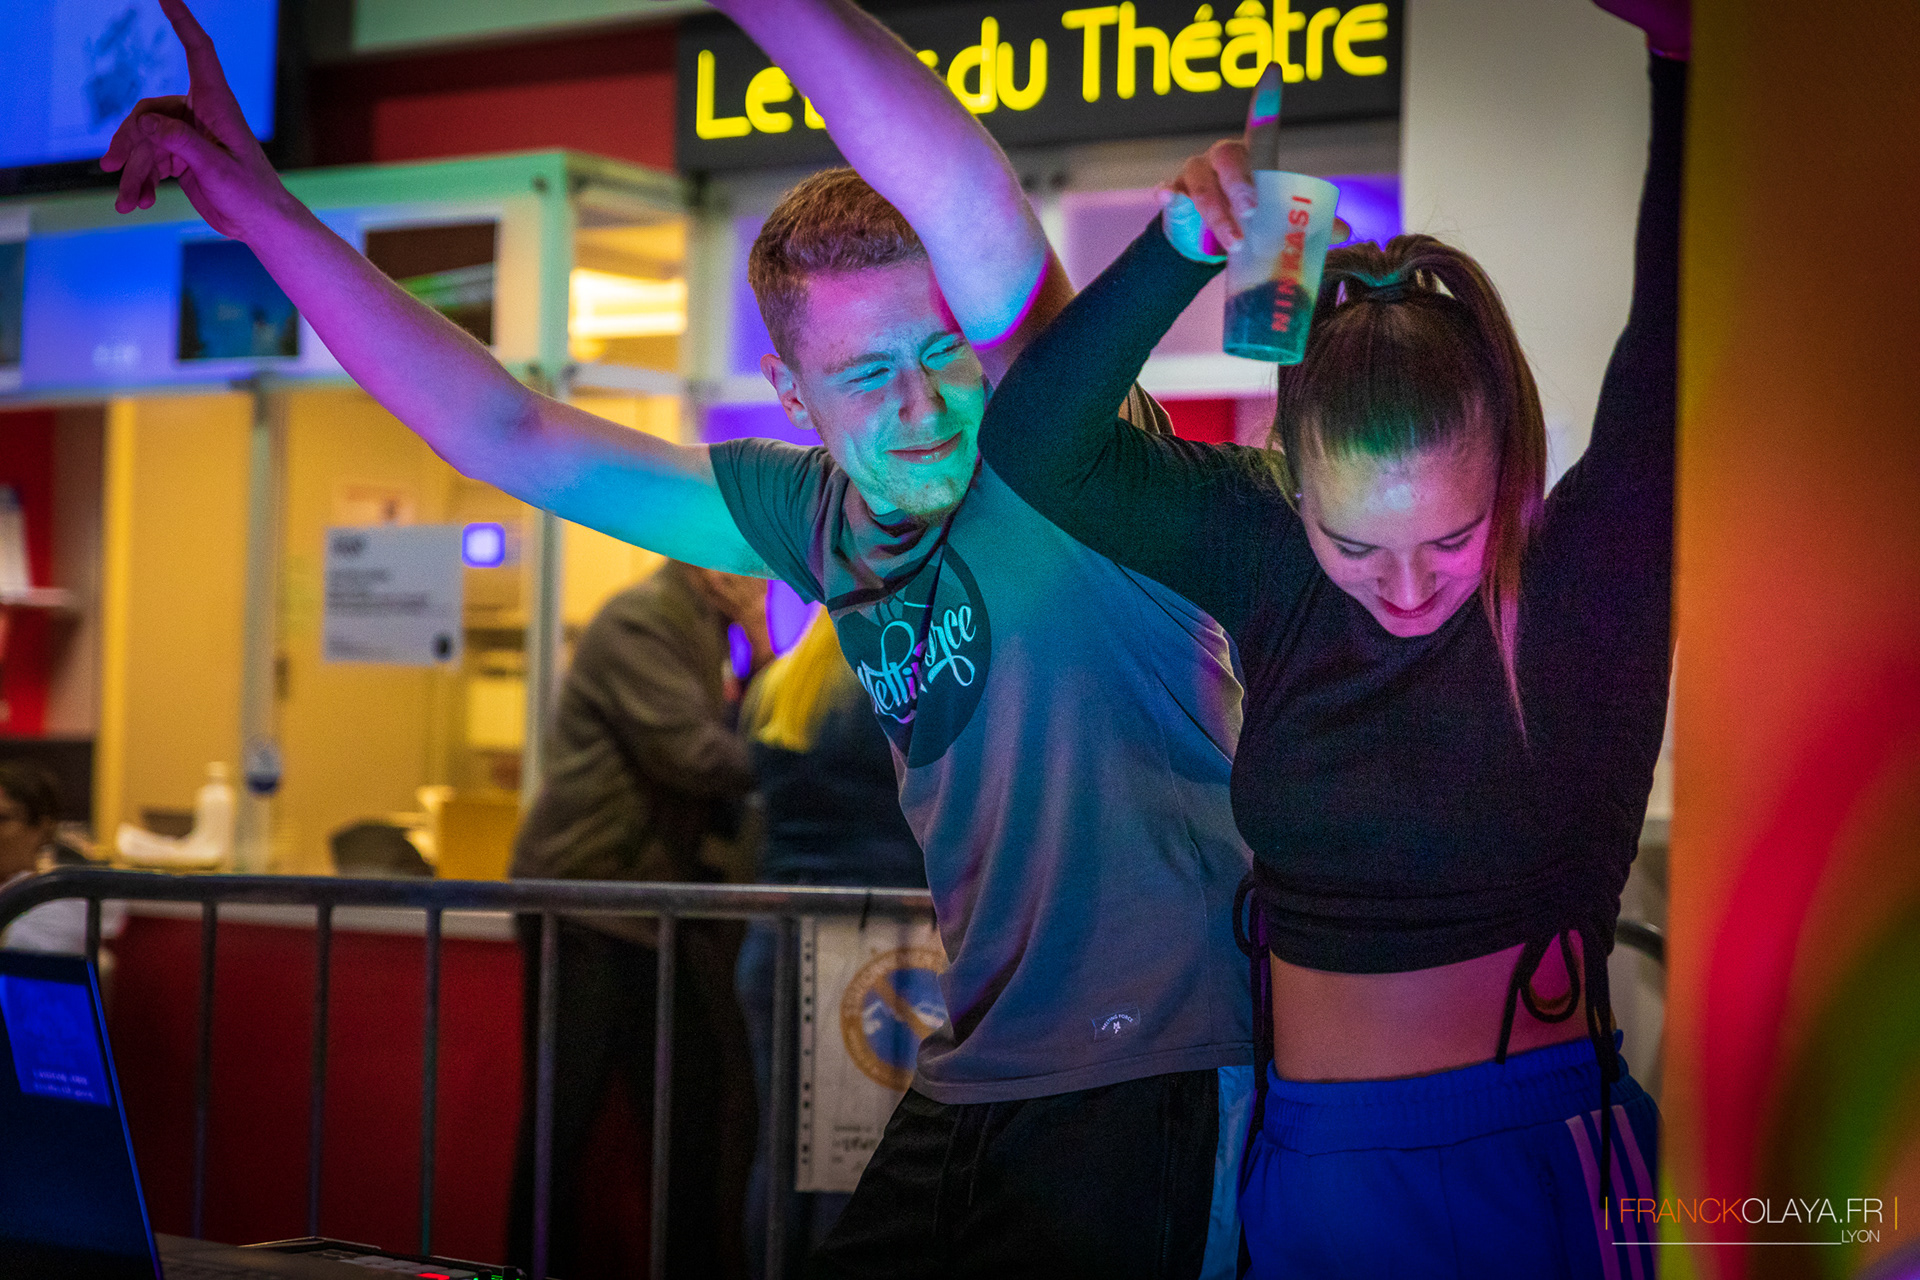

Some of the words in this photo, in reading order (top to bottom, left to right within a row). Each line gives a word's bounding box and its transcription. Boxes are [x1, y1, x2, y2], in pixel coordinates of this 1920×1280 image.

[696, 50, 793, 140] Le
[946, 16, 1048, 114] du
[1061, 0, 1388, 101] Théâtre
[1271, 195, 1313, 333] NINKASI
